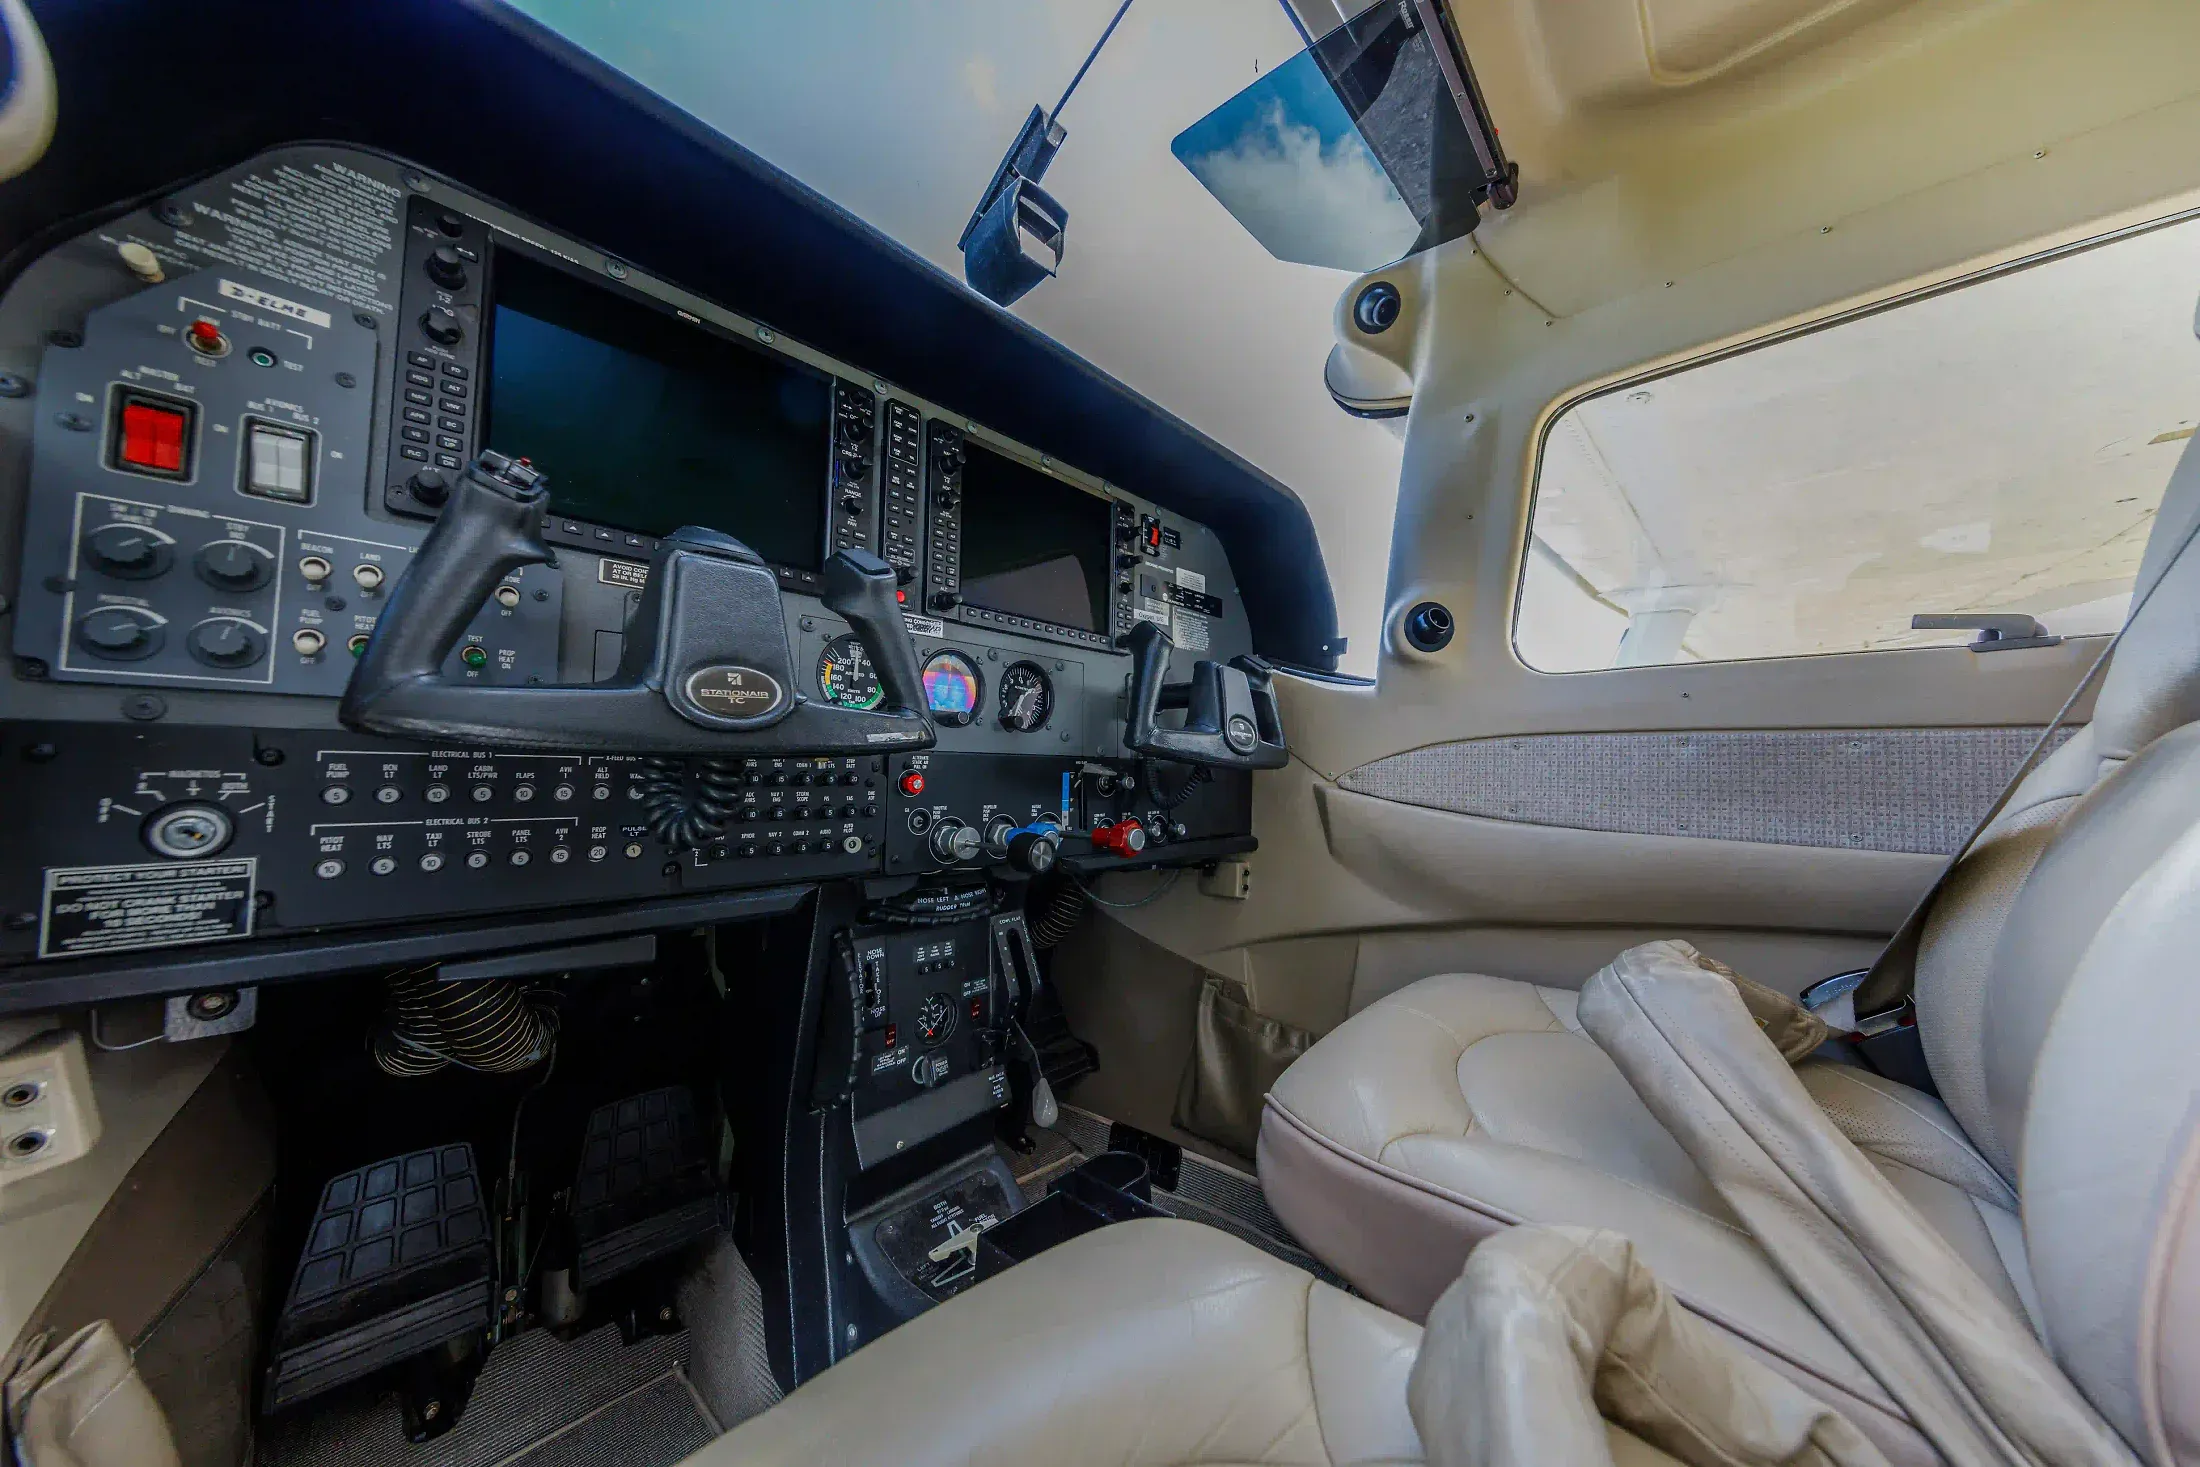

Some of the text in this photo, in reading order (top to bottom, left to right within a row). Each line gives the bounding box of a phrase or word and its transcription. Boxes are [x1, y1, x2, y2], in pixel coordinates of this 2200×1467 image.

[331, 161, 401, 198] WARNING
[301, 543, 334, 554] BEACON
[360, 553, 381, 562] LAND
[612, 563, 632, 571] AVOID
[306, 584, 323, 592] OFF
[302, 609, 321, 618] FUEL
[501, 609, 512, 617] OFF
[299, 616, 323, 625] PUMP
[467, 635, 483, 643] TEST
[499, 649, 515, 658] PROP
[300, 657, 316, 665] OFF
[499, 656, 515, 664] HEAT
[501, 662, 511, 670] ON
[467, 670, 479, 678] OFF
[701, 688, 768, 697] STATIONAIR
[329, 763, 347, 771] FUEL
[383, 764, 398, 772] BCN
[326, 771, 350, 779] PUMP
[333, 792, 340, 800] 5
[385, 791, 392, 800] 5
[432, 791, 441, 799] 10
[520, 790, 528, 798] 10
[425, 818, 464, 826] ELECTRICAL
[320, 836, 345, 844] PITOT
[321, 844, 343, 852] HEAT
[377, 842, 392, 850] LTS
[593, 848, 603, 856] 20
[426, 859, 436, 868] 10
[474, 856, 480, 865] 5
[324, 865, 335, 874] 10
[380, 862, 387, 871] 5
[55, 903, 83, 913] DO
[84, 900, 119, 911] NOT
[121, 896, 177, 908] CRANK
[177, 890, 244, 903] STARTER
[88, 909, 124, 919] FOR
[174, 901, 215, 912] THAN
[936, 904, 958, 912] RUDDER
[870, 1006, 886, 1014] NOSE
[933, 1200, 947, 1210] BOTH
[975, 1213, 986, 1222] FUEL
